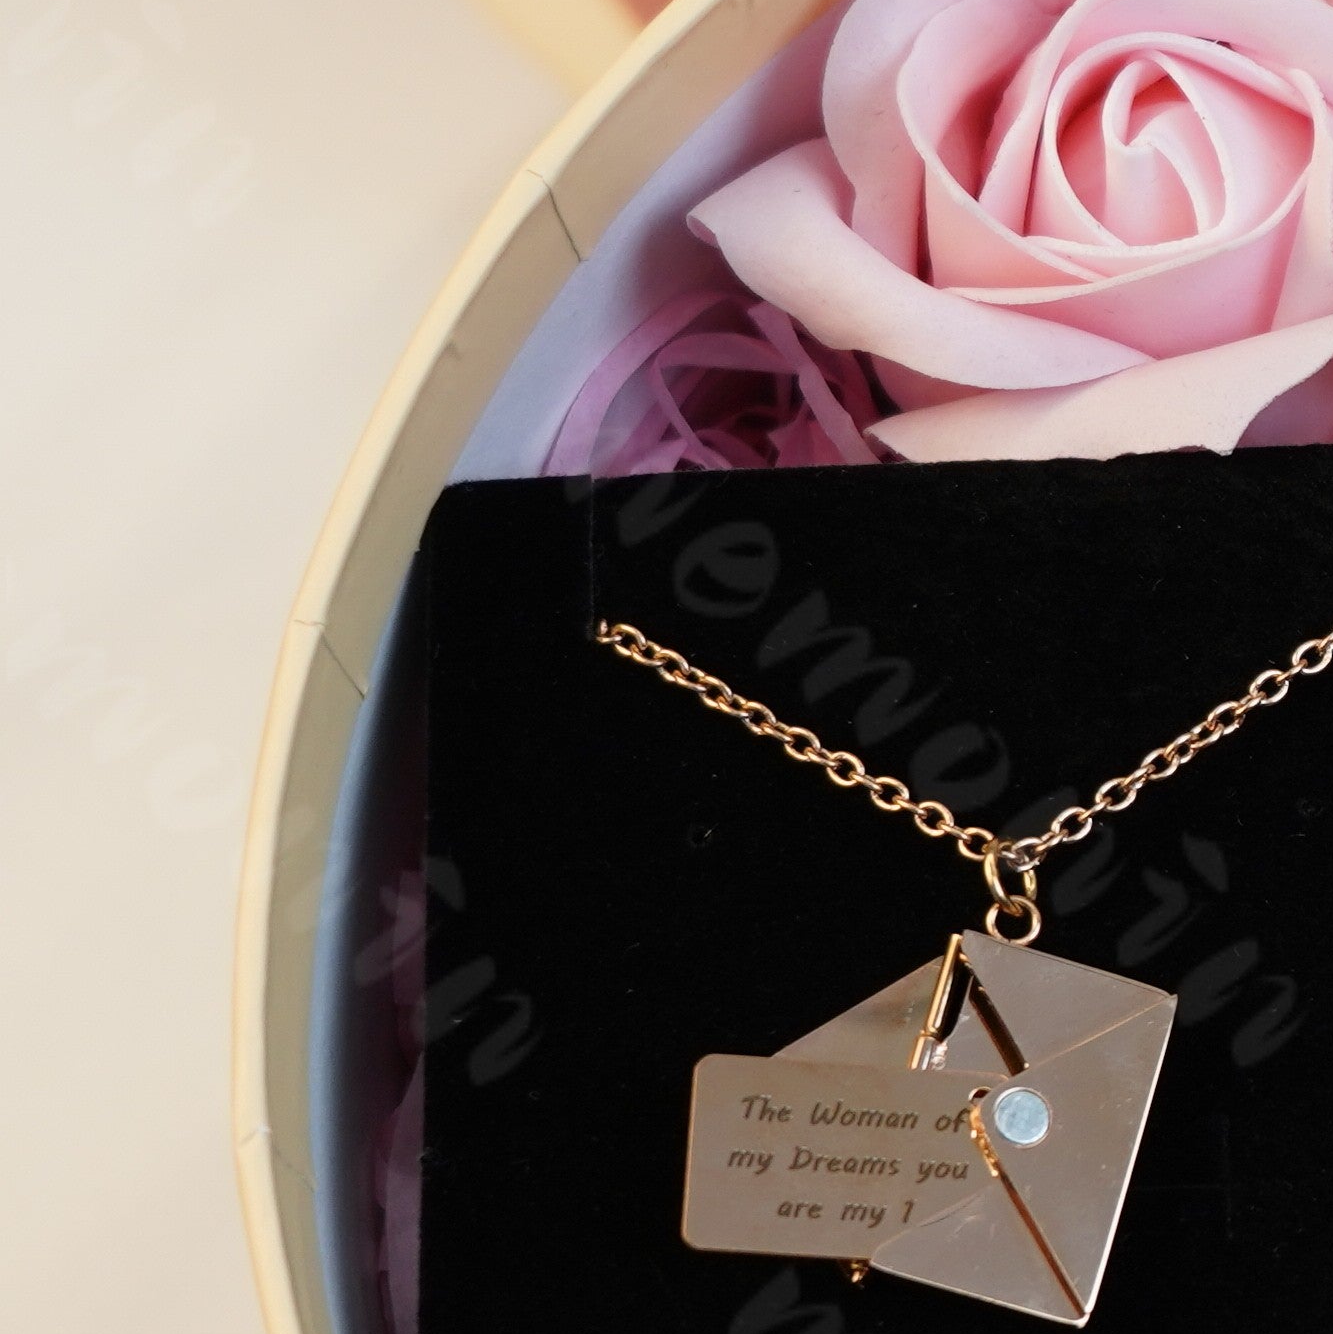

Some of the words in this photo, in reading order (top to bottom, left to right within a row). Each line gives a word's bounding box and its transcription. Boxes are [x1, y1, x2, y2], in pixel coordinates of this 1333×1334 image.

[741, 1094, 793, 1123] The
[809, 1099, 919, 1130] Woman
[935, 1107, 971, 1133] of
[727, 1148, 774, 1175] my
[788, 1145, 902, 1177] Dreams
[915, 1160, 969, 1184] you
[777, 1199, 823, 1219] are
[840, 1202, 888, 1228] my
